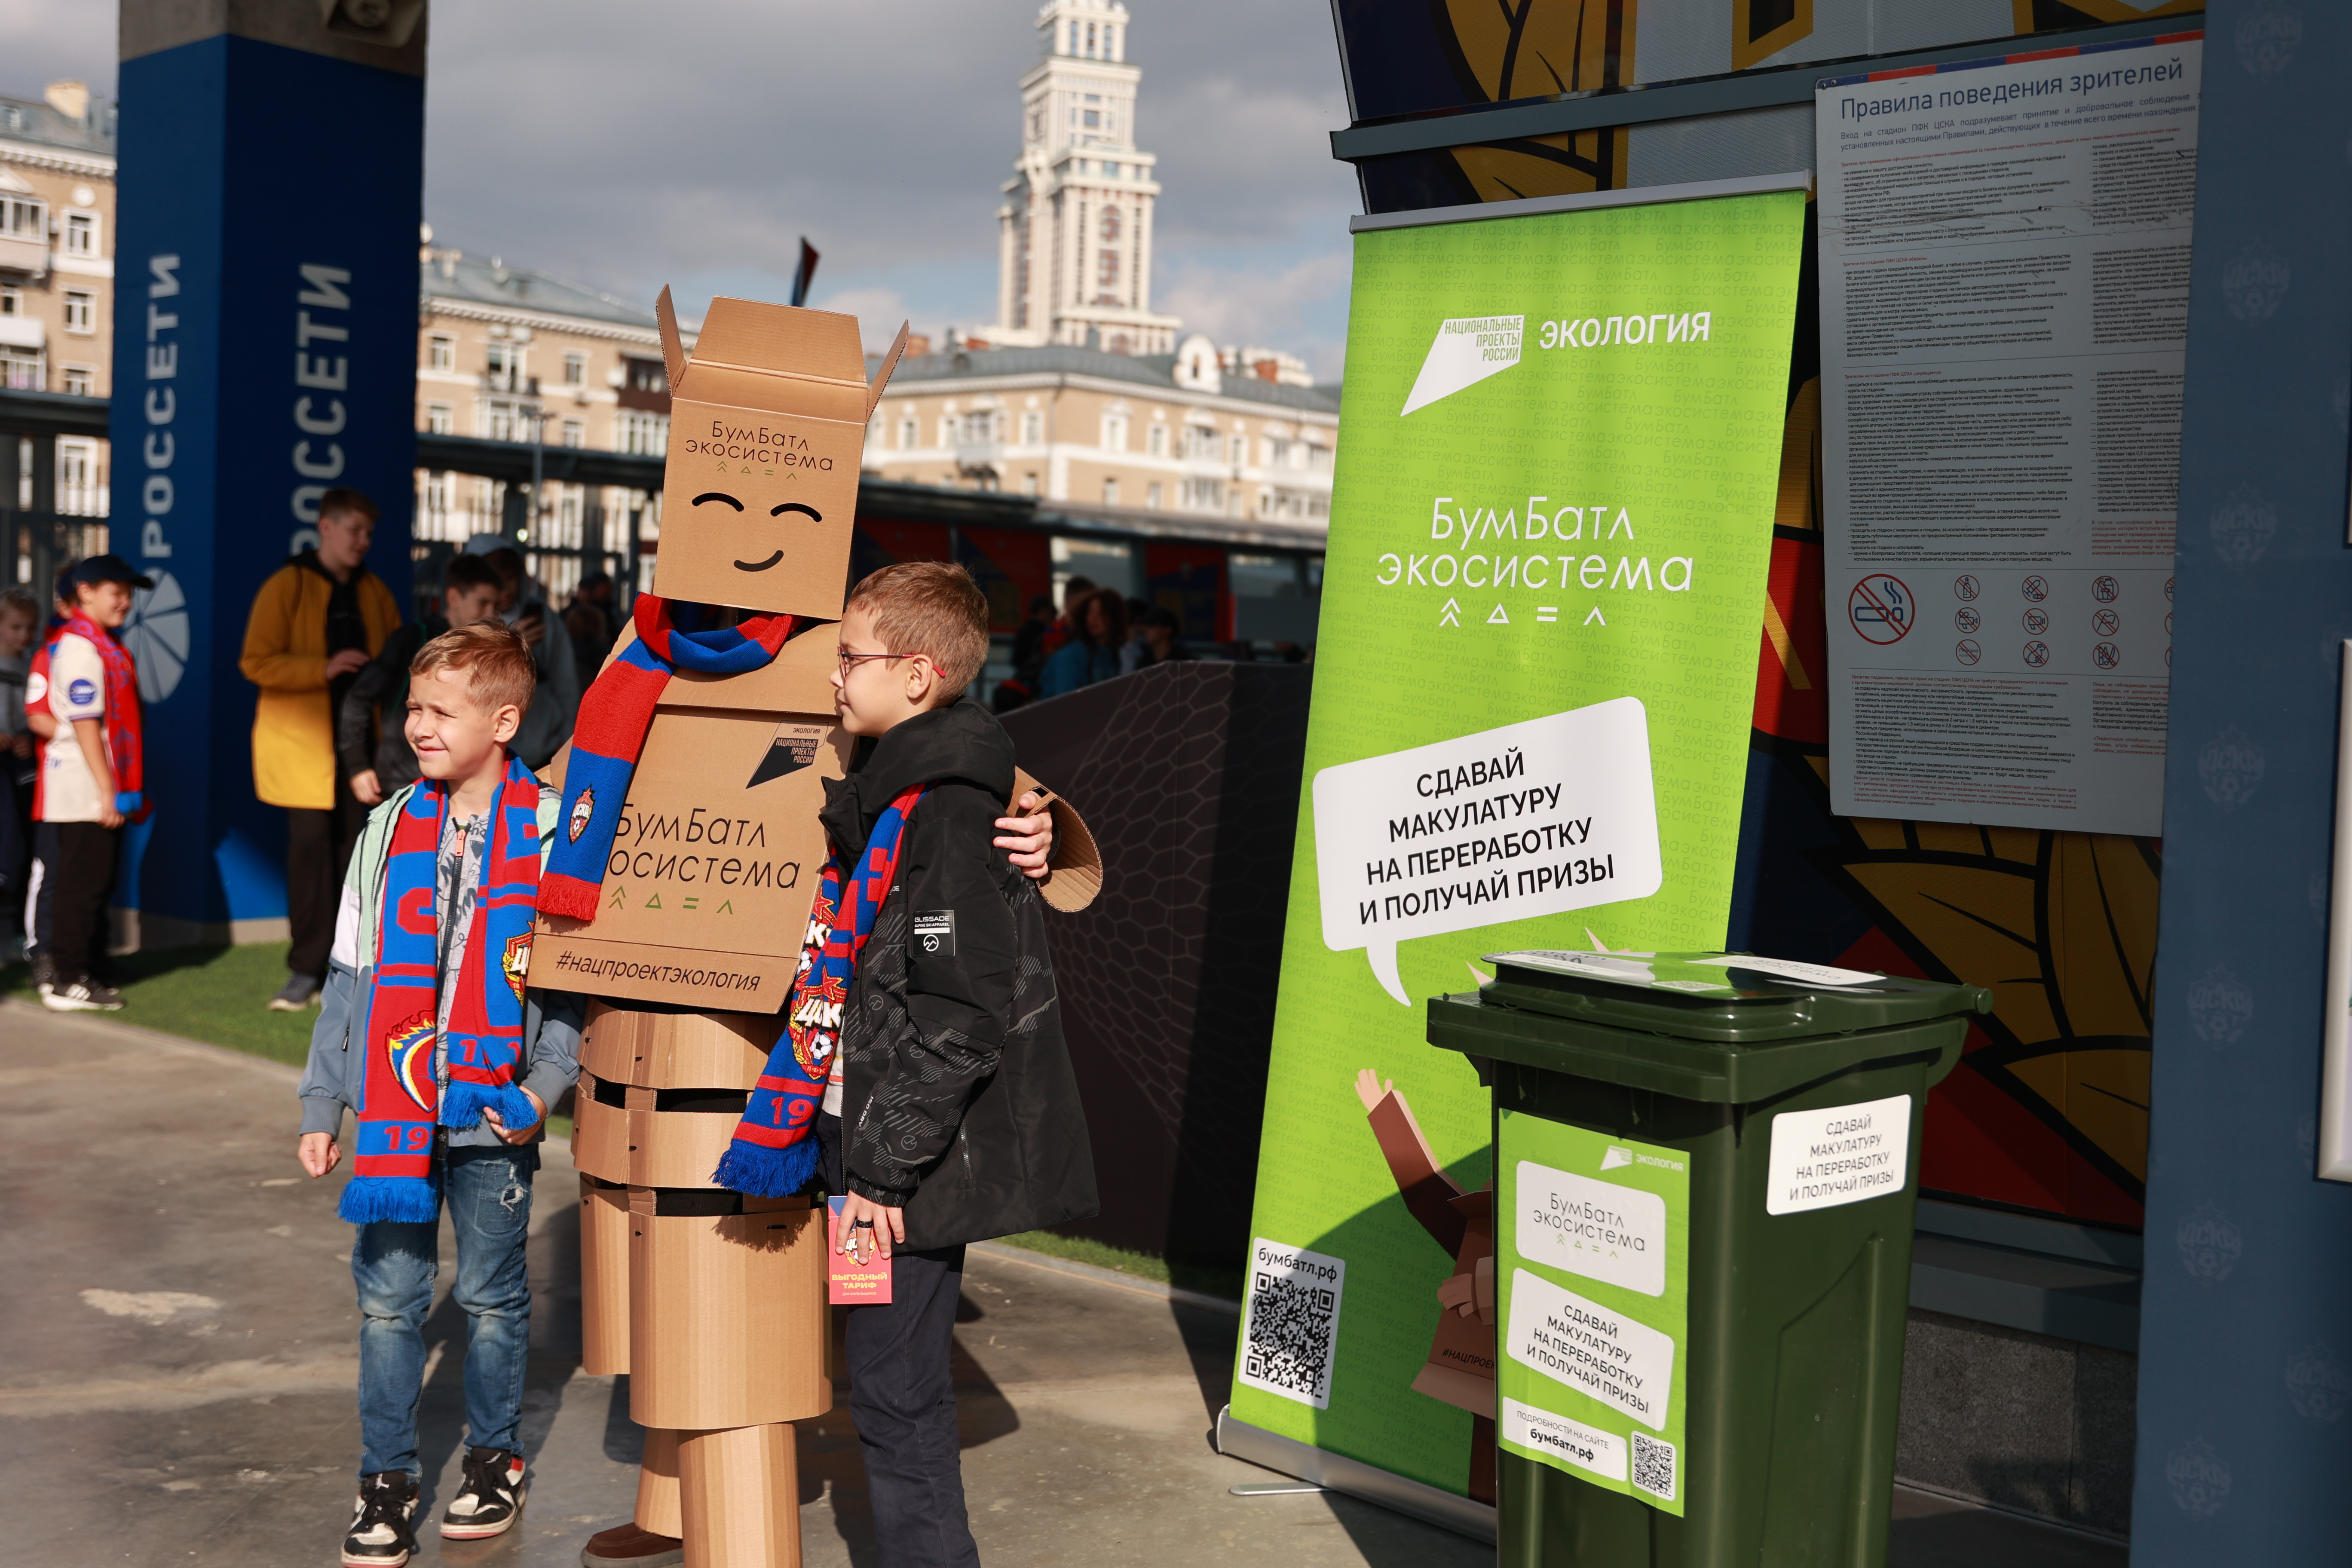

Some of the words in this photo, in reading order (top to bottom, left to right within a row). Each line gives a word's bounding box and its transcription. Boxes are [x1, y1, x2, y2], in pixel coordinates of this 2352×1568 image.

[1841, 94, 1933, 123] Правила
[1940, 78, 2062, 108] поведения
[2070, 57, 2182, 96] зрителей
[1841, 139, 1894, 152] установленных
[1896, 134, 1941, 144] настоящими
[1943, 129, 1987, 141] Правилами,
[1988, 122, 2040, 135] действующих
[2051, 118, 2082, 127] течение
[2084, 116, 2106, 124] всего
[2108, 112, 2142, 122] времени
[2144, 106, 2195, 117] нахождения
[1877, 127, 1906, 136] стадион
[1912, 122, 1929, 132] ПФК
[1934, 119, 1955, 130] ЦСКА
[1960, 114, 2017, 126] подразумевает
[2023, 109, 2059, 120] принятие
[2076, 101, 2133, 114] добровольное
[2139, 94, 2190, 106] соблюдение
[1444, 317, 1522, 334] НАЦИОНАЛЬНЫЕ
[1476, 332, 1520, 347] ПРОЕКТЫ
[1539, 312, 1711, 349] ЭКОЛОГИЯ
[1482, 347, 1519, 361] РОССИИ
[141, 253, 181, 558] РОССЕТИ
[712, 421, 809, 451] БумБатл
[685, 439, 833, 471] экосистема
[1431, 496, 1634, 550] БумБатл
[1376, 553, 1693, 591] экосистема
[775, 738, 818, 748] НАЦИОНАЛЬНЫЕ
[791, 747, 815, 756] ПРОЕКТЫ
[793, 755, 814, 764] РОССИИ
[1417, 746, 1524, 798] СДАВАЙ
[572, 803, 590, 818] ЦСКА
[615, 803, 766, 848] БумБатл
[1389, 783, 1562, 842] МАКУЛАТУРУ
[1366, 860, 1402, 885] НА
[1408, 817, 1592, 878] ПЕРЕРАБОТКУ
[609, 850, 801, 889] осистема
[1359, 900, 1378, 925] И
[1385, 868, 1510, 921] ПОЛУЧАЙ
[1517, 854, 1614, 896] ПРИЗЫ
[556, 950, 761, 992] #нацпроектэкология
[772, 1096, 814, 1126] 19
[858, 1110, 867, 1127] DRY
[866, 1096, 874, 1110] ISO
[384, 1126, 435, 1151] 19
[1825, 1113, 1871, 1136] СДАВАЙ
[1636, 1153, 1684, 1172] ЭКОЛОГИЯ
[1810, 1133, 1883, 1158] МАКУЛАТУРУ
[1796, 1165, 1813, 1180] НА
[1815, 1151, 1890, 1177] ПЕРЕРАБОТКУ
[1789, 1188, 1798, 1200] И
[1801, 1175, 1857, 1199] ПОЛУЧАЙ
[1859, 1169, 1894, 1189] ПРИЗЫ
[1551, 1192, 1625, 1228] БумБатл
[1533, 1209, 1645, 1252] экосистема
[831, 1272, 888, 1281] ВЫГОДНЫЙ
[1259, 1247, 1338, 1283] бумбатл.рф
[1564, 1305, 1618, 1338] СДАВАЙ
[1547, 1315, 1632, 1364] МАКУЛАТУРУ
[1533, 1328, 1550, 1346] НА
[1552, 1336, 1644, 1389] ПЕРЕРАБОТКУ
[1527, 1343, 1536, 1357] И
[1538, 1348, 1600, 1389] ПОЛУЧАЙ
[1602, 1381, 1649, 1414] ПРИЗЫ
[1516, 1410, 1573, 1435] ПОДРОБНОСТИ
[1573, 1429, 1583, 1440] НА
[1584, 1432, 1609, 1449] САЙТЕ
[1530, 1428, 1595, 1462] бумбатл.рф
